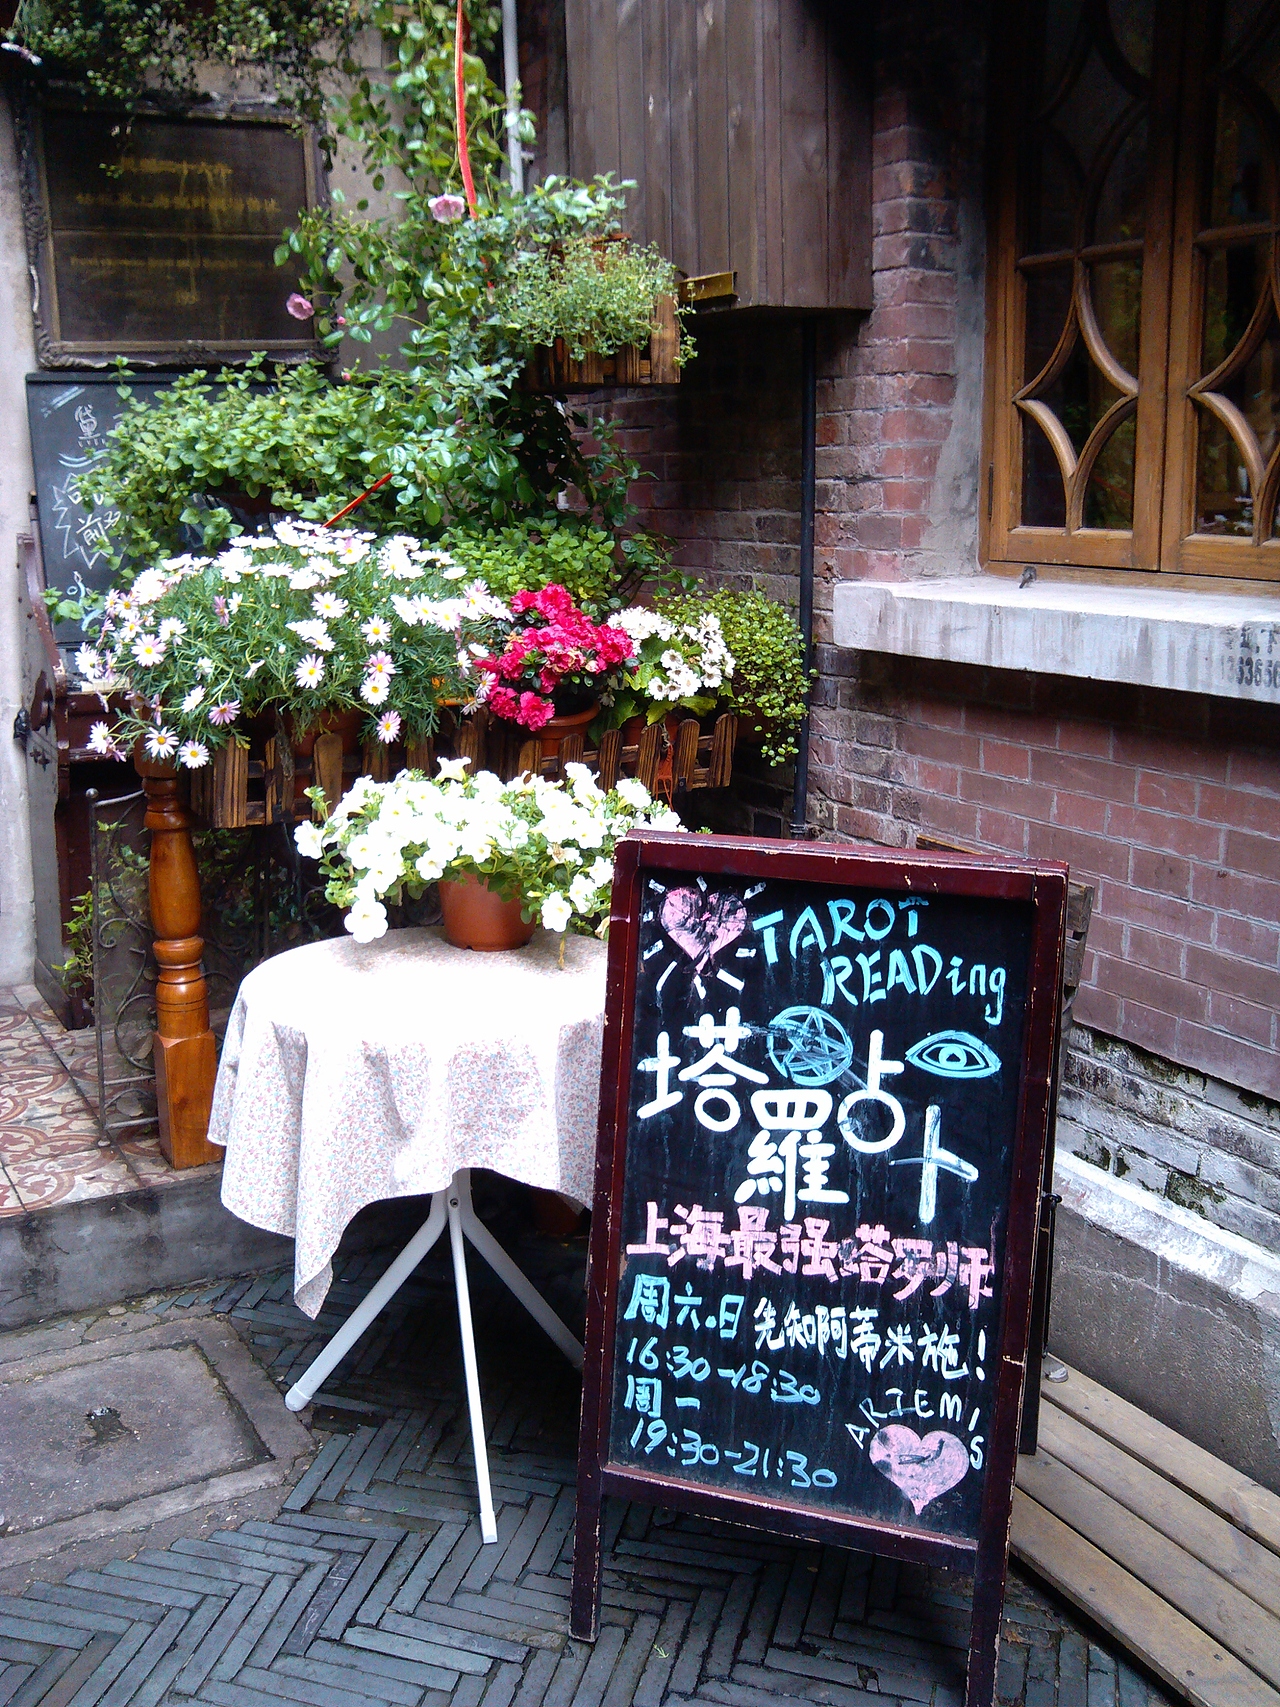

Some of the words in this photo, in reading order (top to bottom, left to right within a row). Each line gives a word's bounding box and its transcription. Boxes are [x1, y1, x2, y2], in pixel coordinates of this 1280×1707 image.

[752, 896, 929, 967] TAROT
[820, 944, 1006, 1026] READing
[626, 1201, 995, 1310] 上海最强塔罗师
[624, 1374, 701, 1418] 周一
[626, 1336, 822, 1405] 16:30-18:30
[630, 1418, 838, 1488] 19:30-21:30
[845, 1388, 985, 1470] ARTEMIS
